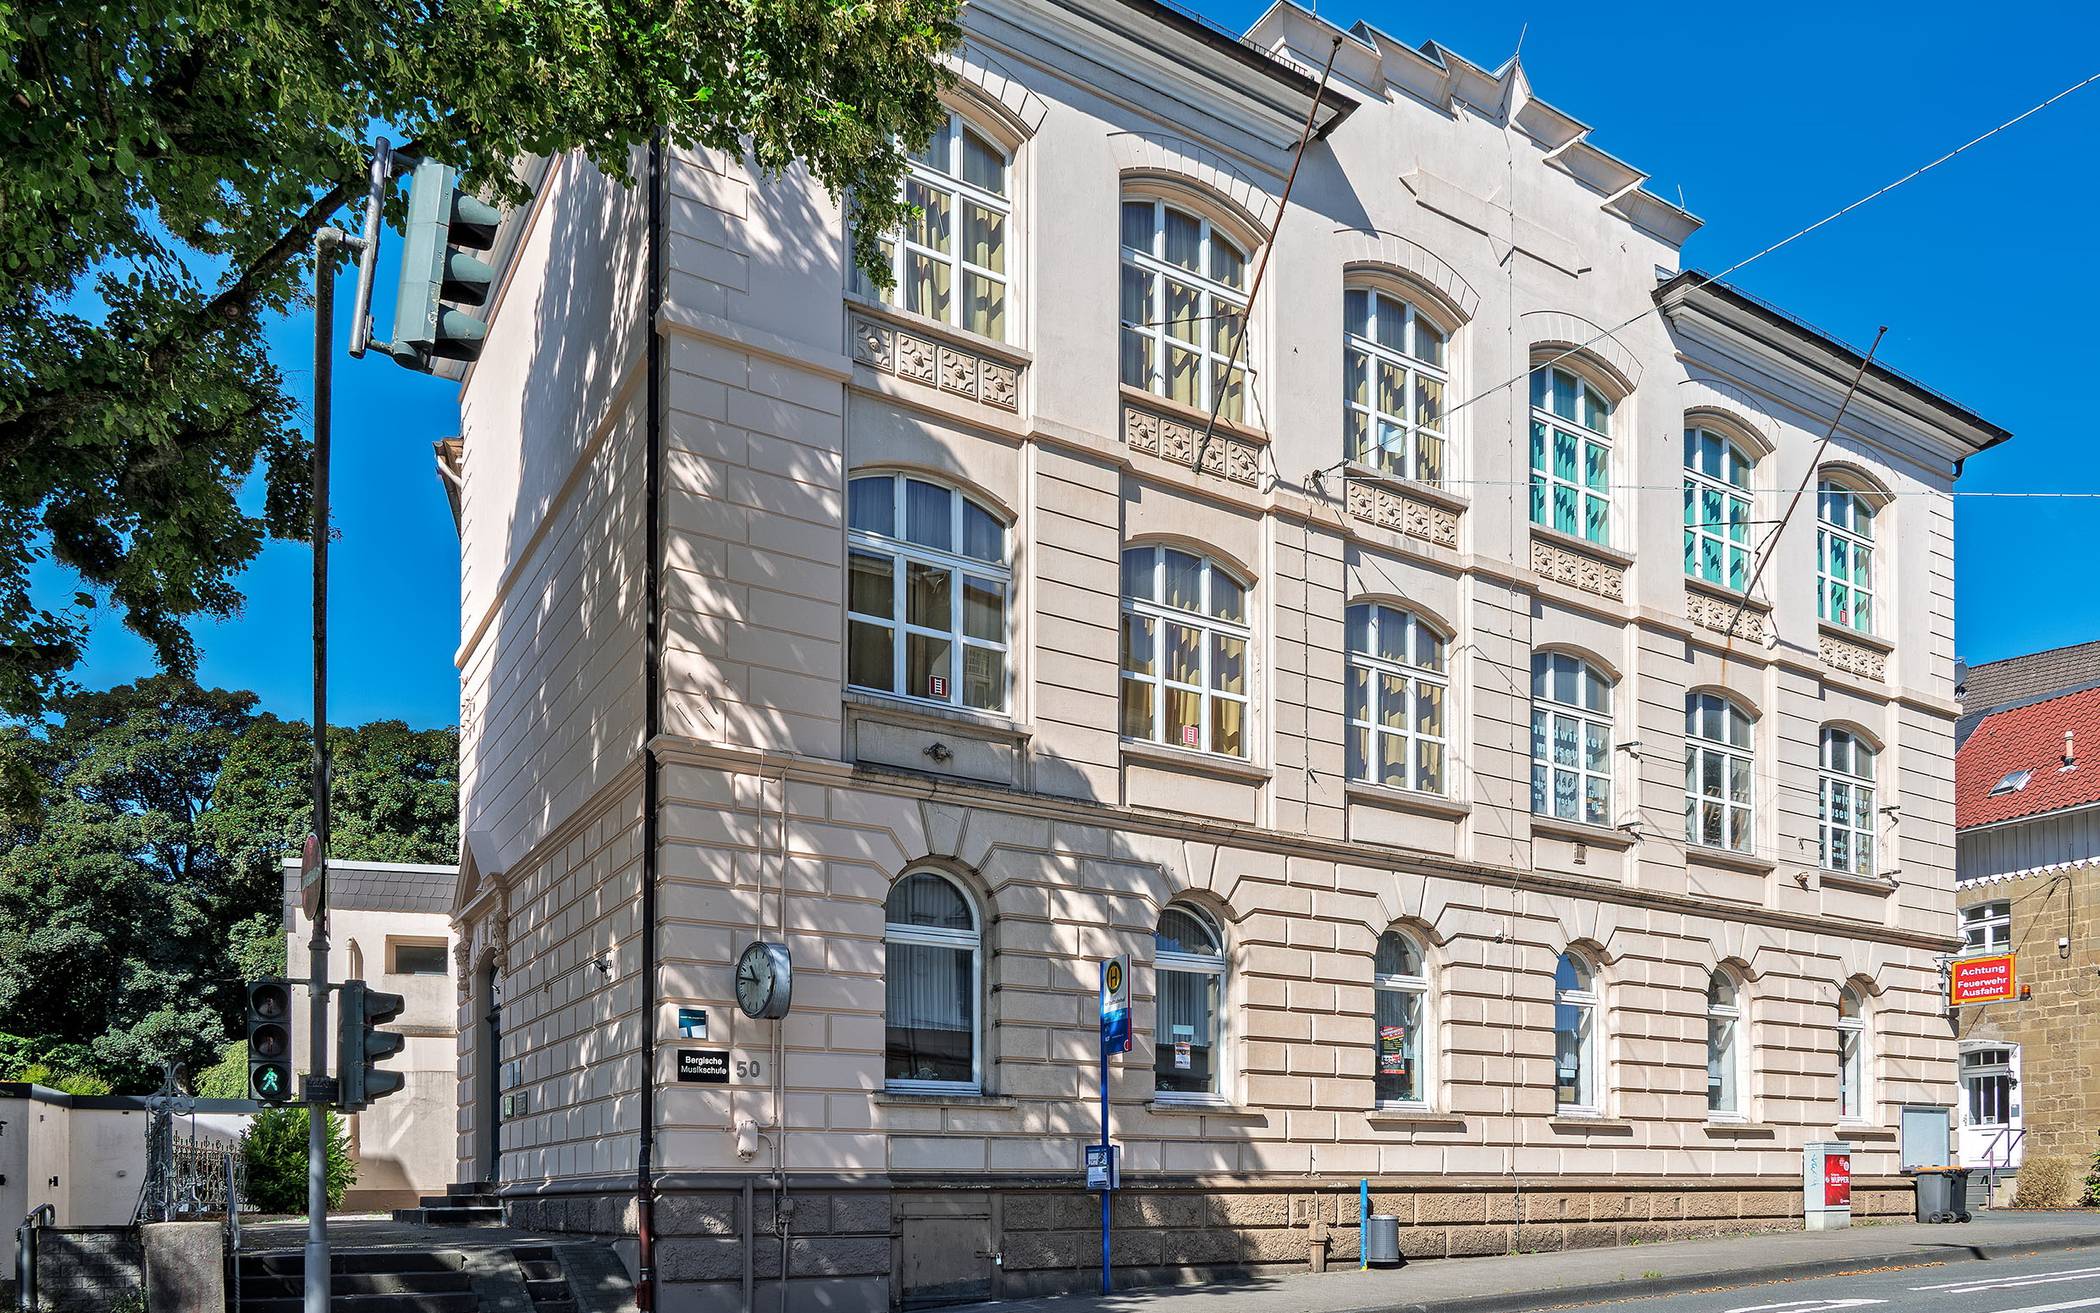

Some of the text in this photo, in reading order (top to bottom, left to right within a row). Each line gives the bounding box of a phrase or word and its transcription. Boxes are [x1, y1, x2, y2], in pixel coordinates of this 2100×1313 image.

[1960, 965, 2006, 977] Achtung
[1957, 976, 2008, 988] Feuerwehr
[1962, 986, 2004, 997] Ausfahrt
[685, 1056, 723, 1066] Bergische
[680, 1066, 728, 1075] Musikschule
[736, 1060, 761, 1078] 50
